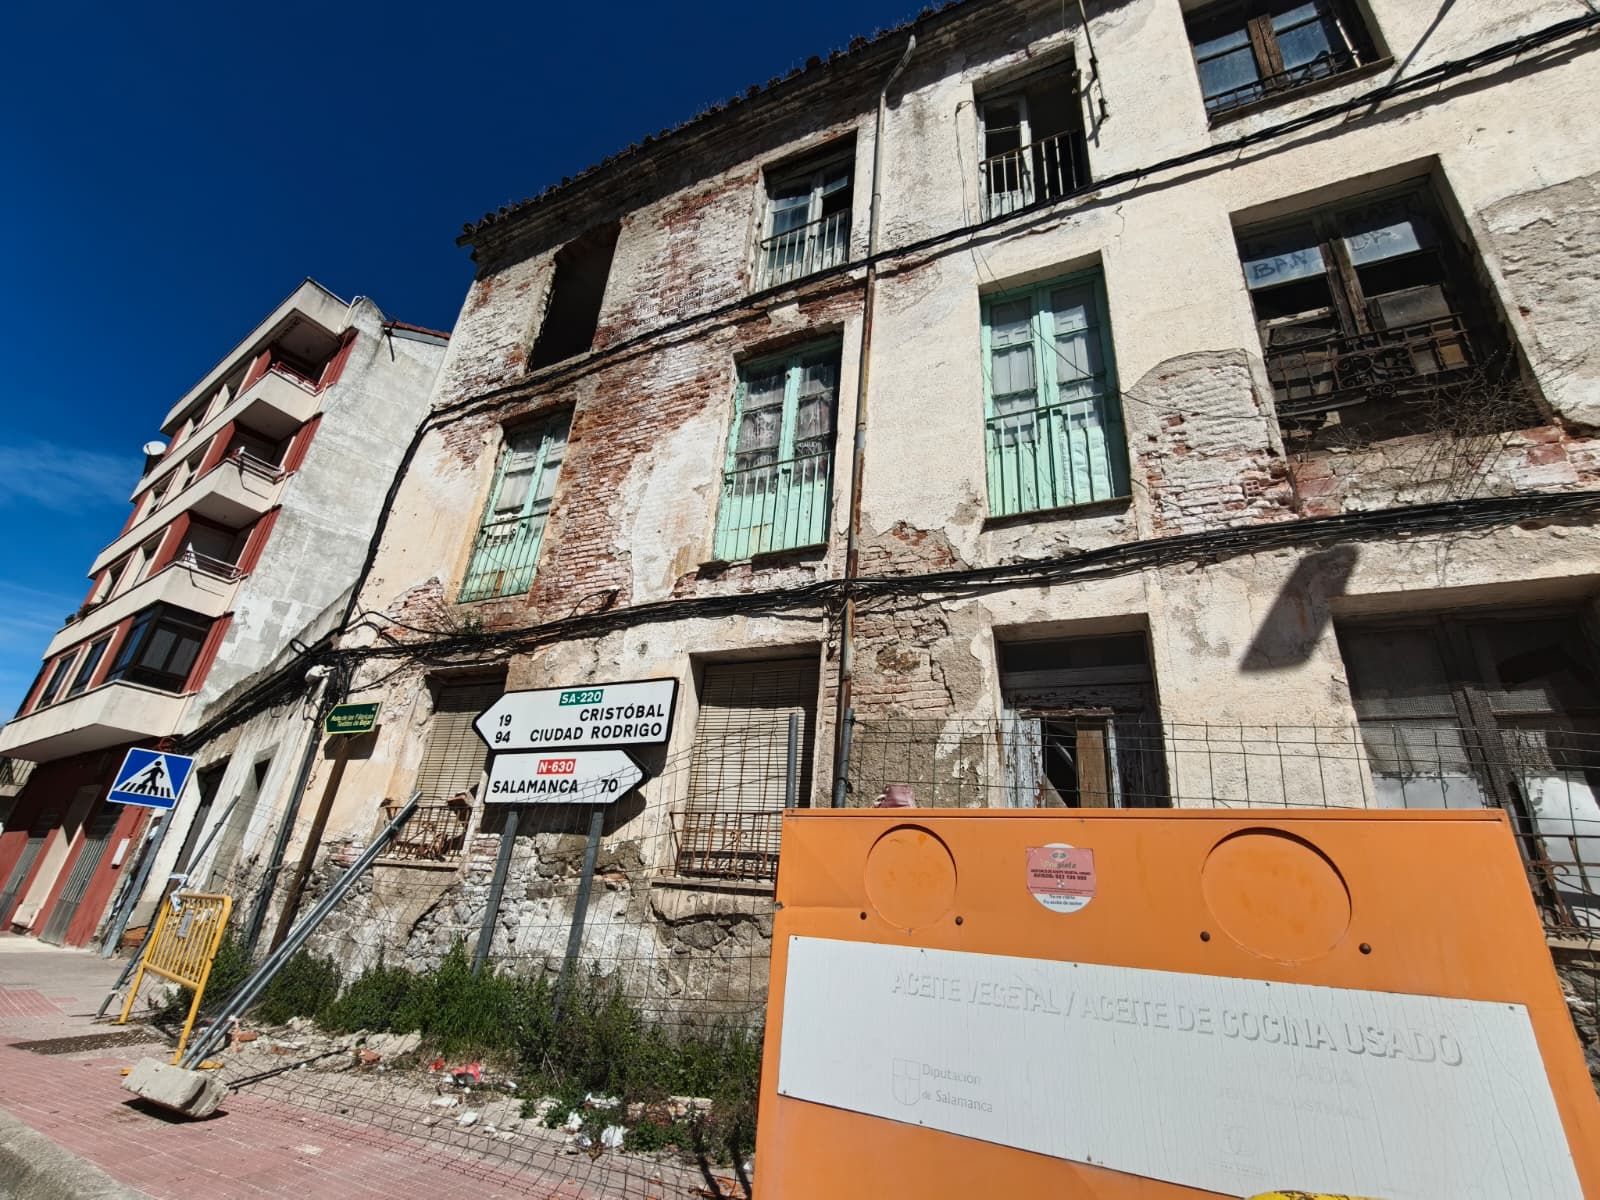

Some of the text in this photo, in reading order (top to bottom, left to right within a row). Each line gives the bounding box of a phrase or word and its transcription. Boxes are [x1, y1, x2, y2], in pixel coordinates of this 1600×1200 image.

[560, 691, 602, 704] SA-220
[499, 703, 665, 727] 19 CRISTÓBAL
[495, 722, 662, 744] 94 CIUDAD RODRIGO
[538, 761, 574, 774] N-630
[492, 778, 619, 794] SALAMANCA 70
[891, 973, 961, 1001] ACEITE
[1082, 994, 1171, 1030] ACEITE
[1176, 1005, 1214, 1035] DE
[1222, 1009, 1338, 1052] COCINA
[1343, 1023, 1463, 1067] USADO
[922, 1063, 982, 1086] Diputación
[935, 1089, 993, 1113] Salamanca
